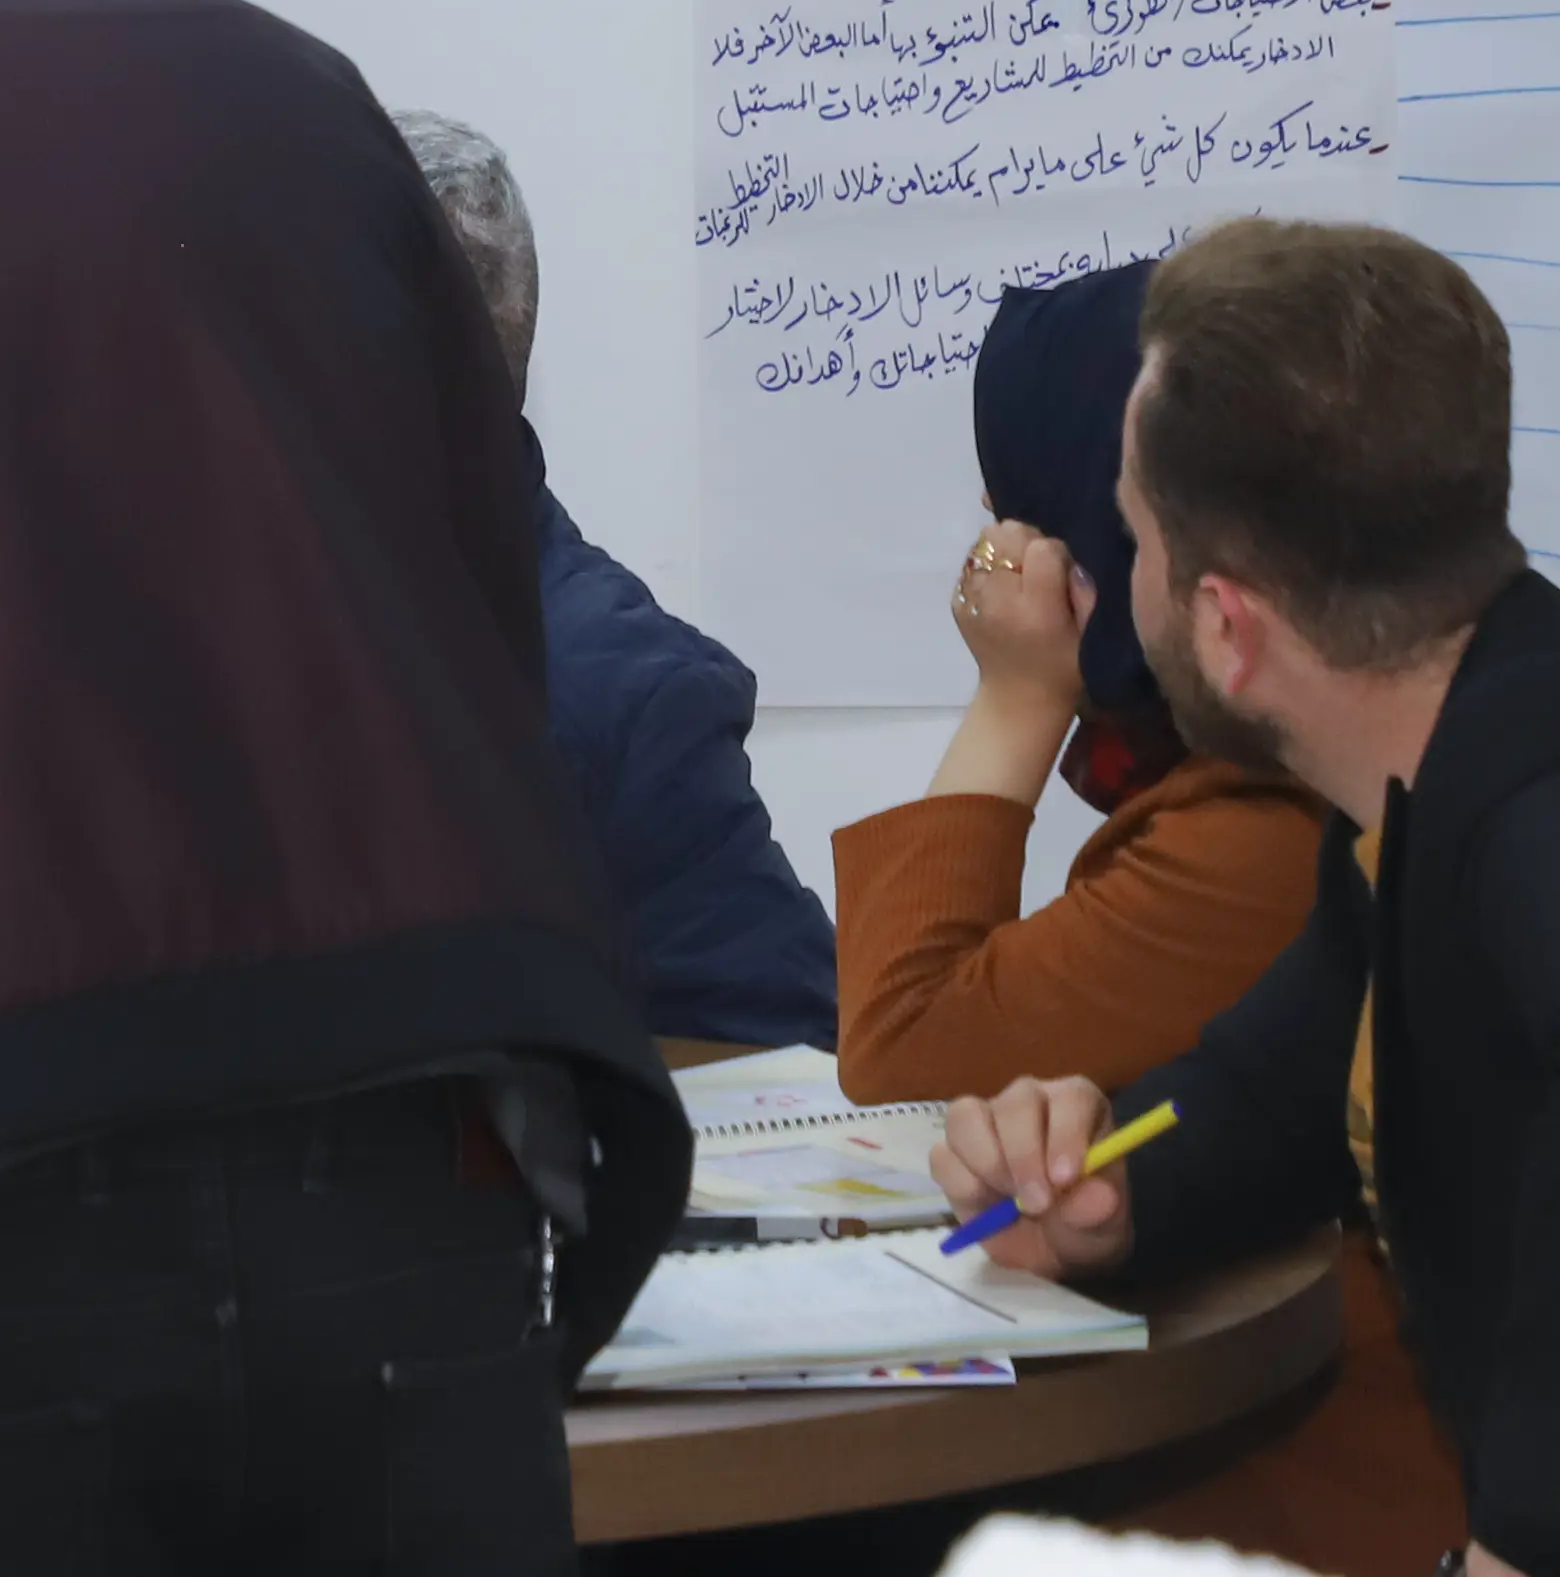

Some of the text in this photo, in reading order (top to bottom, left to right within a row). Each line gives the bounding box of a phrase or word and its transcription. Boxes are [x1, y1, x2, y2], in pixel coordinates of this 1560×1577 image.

[802, 22, 856, 58] البعض
[891, 32, 917, 63] بها
[1145, 45, 1172, 68] من
[1182, 25, 1254, 67] يمكنك
[1246, 35, 1334, 74] الادخار
[1050, 40, 1135, 92] التخطيط
[717, 81, 814, 137] المستقبل
[1187, 112, 1227, 183] كل
[1231, 101, 1313, 169] يكون
[1306, 121, 1372, 157] عندما
[766, 173, 824, 227] الادخار
[833, 161, 884, 203] خلال
[784, 271, 902, 332] الادخار
[898, 265, 973, 329] وسائل
